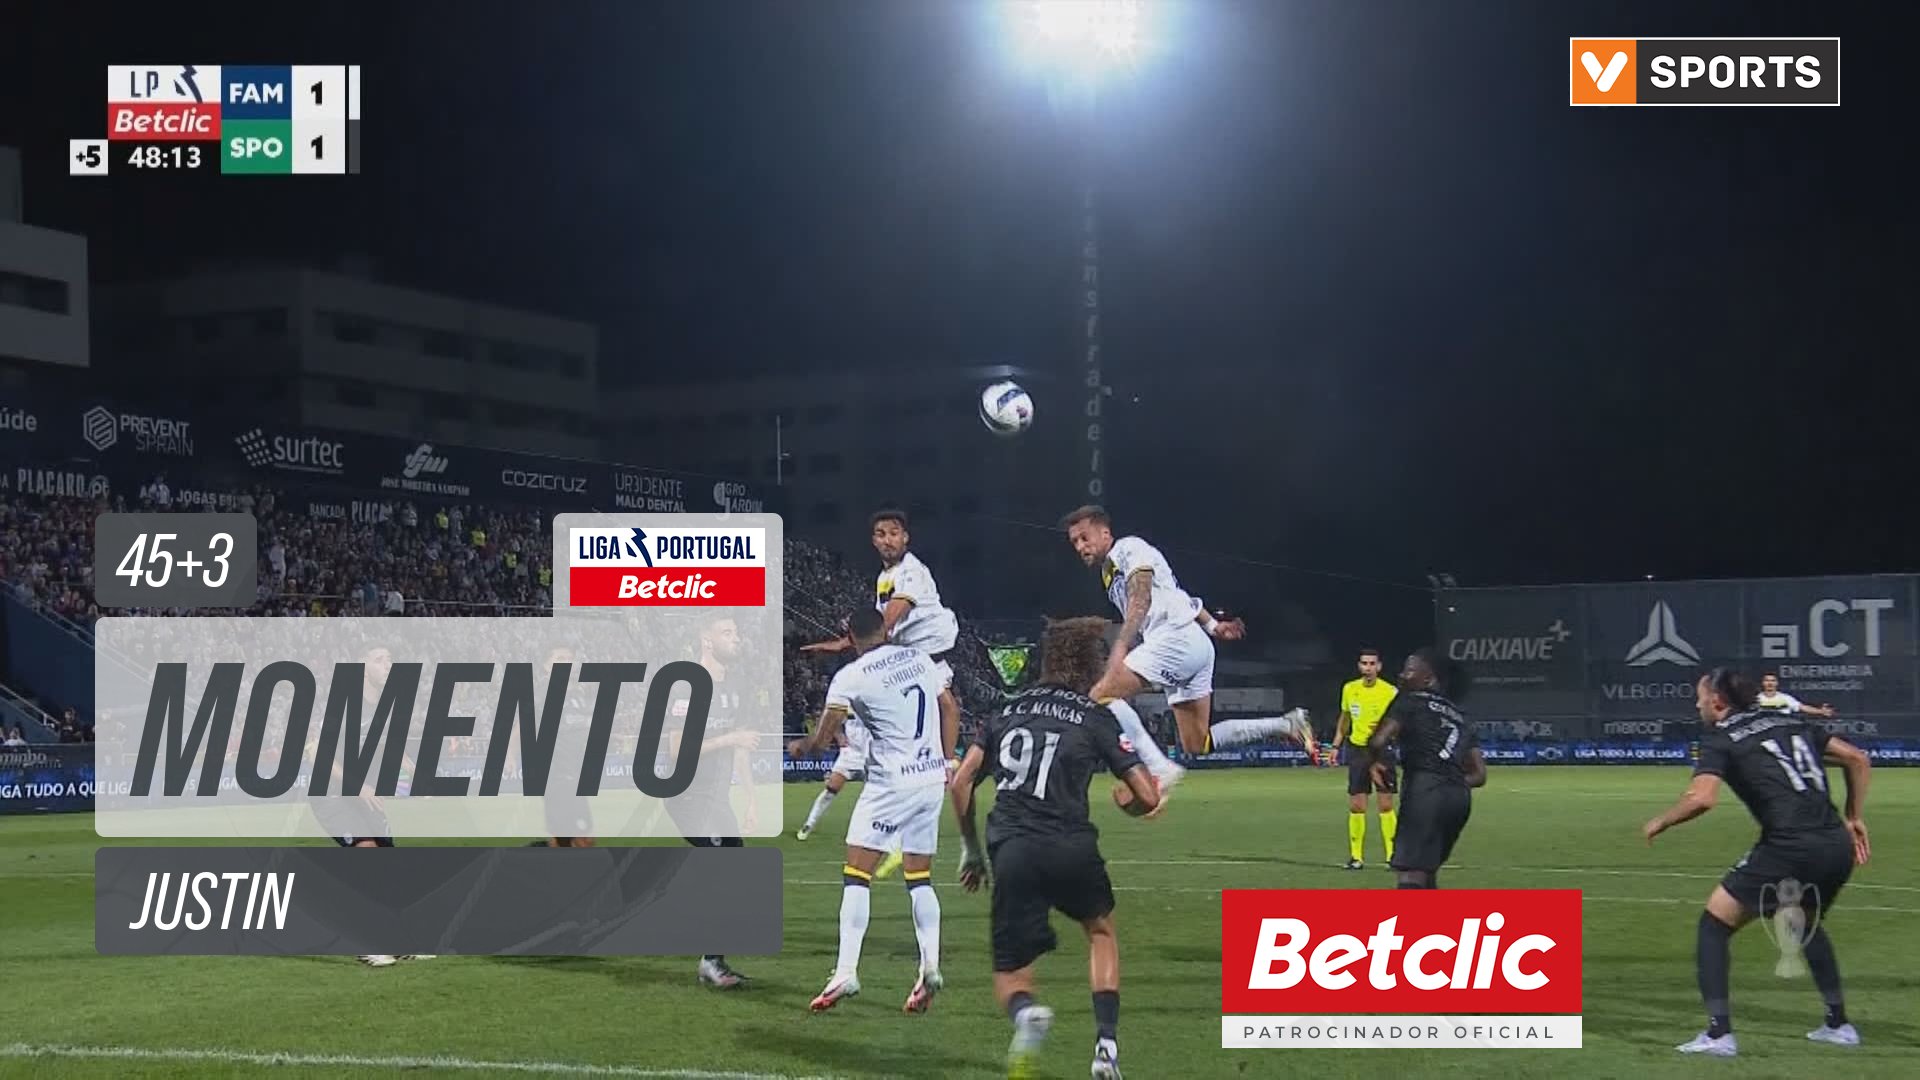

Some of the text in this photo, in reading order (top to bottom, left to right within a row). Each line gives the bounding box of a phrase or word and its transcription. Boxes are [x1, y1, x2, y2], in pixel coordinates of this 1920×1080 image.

[121, 415, 190, 437] PREVENT
[136, 434, 193, 456] SPRAIN
[274, 435, 344, 468] surtec
[615, 495, 645, 508] MALO
[1450, 637, 1553, 660] CAIXIAVE
[1780, 665, 1872, 678] ENGENHARIA
[1603, 683, 1694, 700] VLBGRO
[901, 684, 926, 740] 7
[1030, 701, 1085, 725] MANGAS
[997, 727, 1060, 800] 91
[1760, 734, 1827, 792] 14
[25, 783, 63, 797] TUDO
[66, 782, 76, 796] A
[78, 780, 105, 797] QUE
